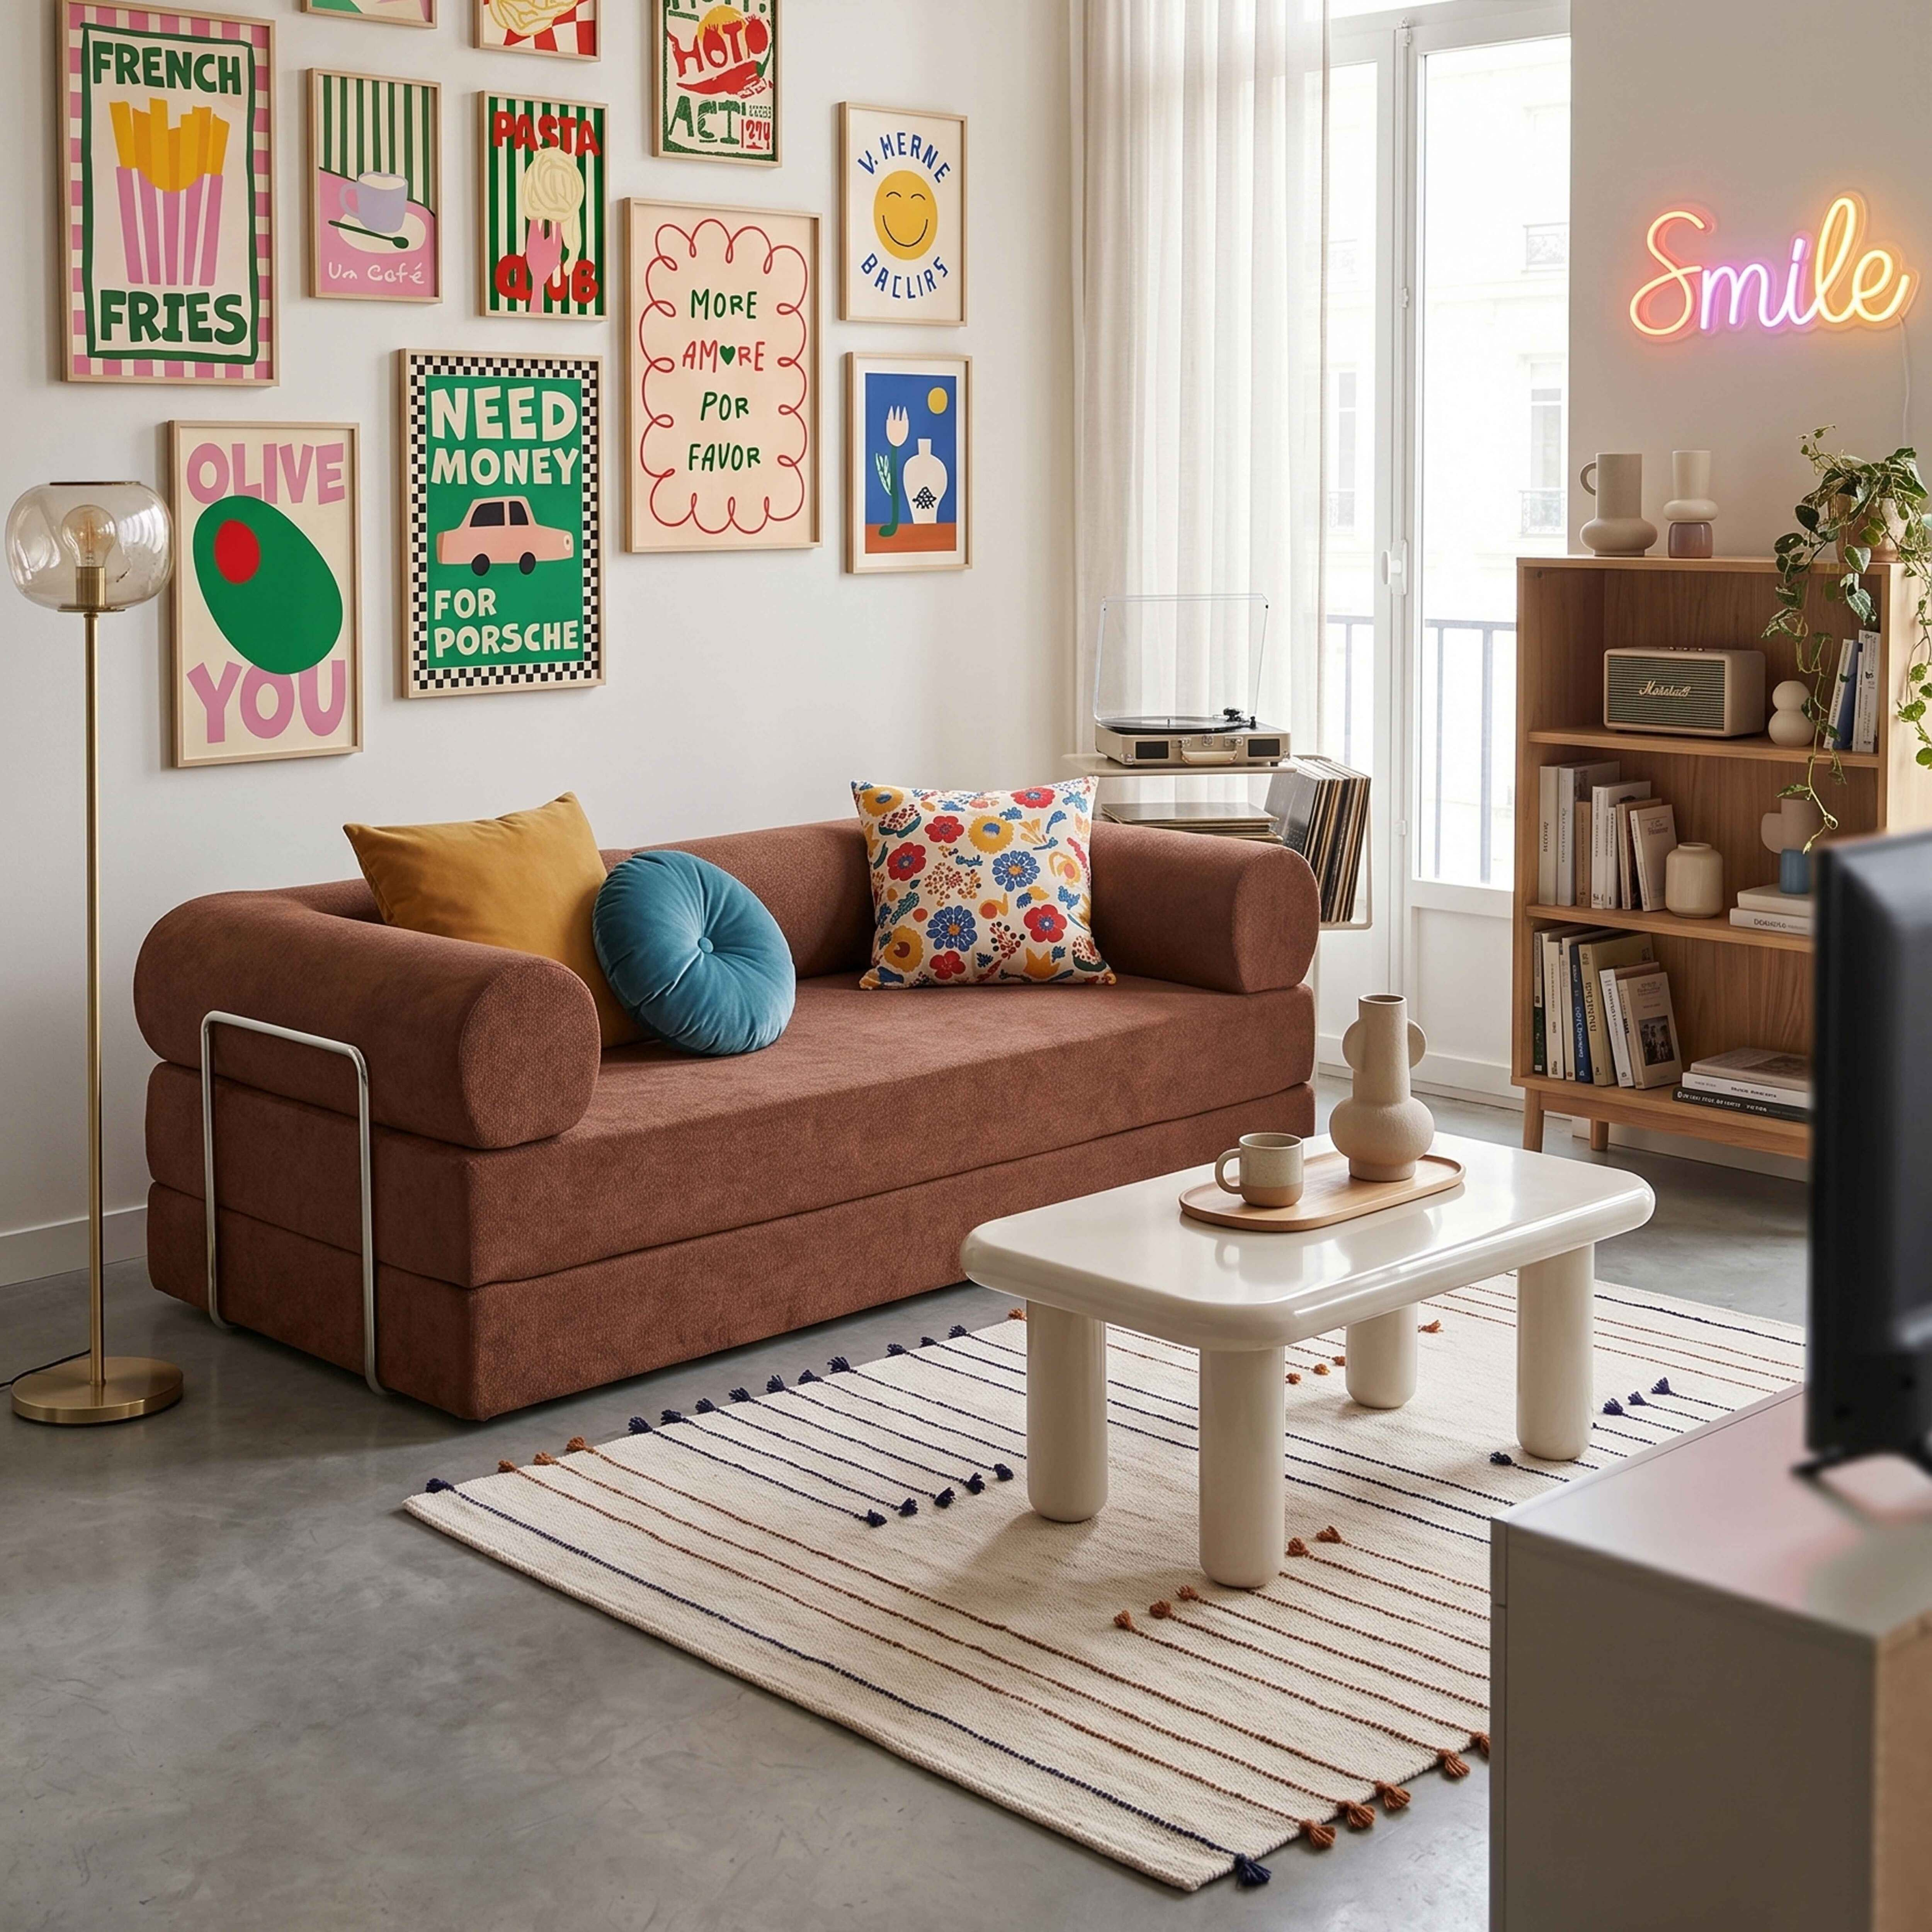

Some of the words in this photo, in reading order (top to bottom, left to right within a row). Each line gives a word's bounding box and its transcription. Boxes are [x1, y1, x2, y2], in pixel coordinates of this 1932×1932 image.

[92, 40, 242, 95] FRENCH
[492, 111, 600, 156] PASTA
[367, 262, 425, 284] Café
[1629, 197, 1910, 335] Smile
[100, 289, 248, 345] FRIES
[690, 288, 757, 320] MORE
[431, 386, 577, 442] NEED
[700, 391, 749, 421] POR
[187, 442, 345, 505] OLIVE
[430, 447, 579, 486] MONEY
[688, 442, 761, 472] FAVOR
[434, 588, 497, 620] FOR
[434, 620, 579, 658] PORSCHE
[186, 660, 346, 744] YOU
